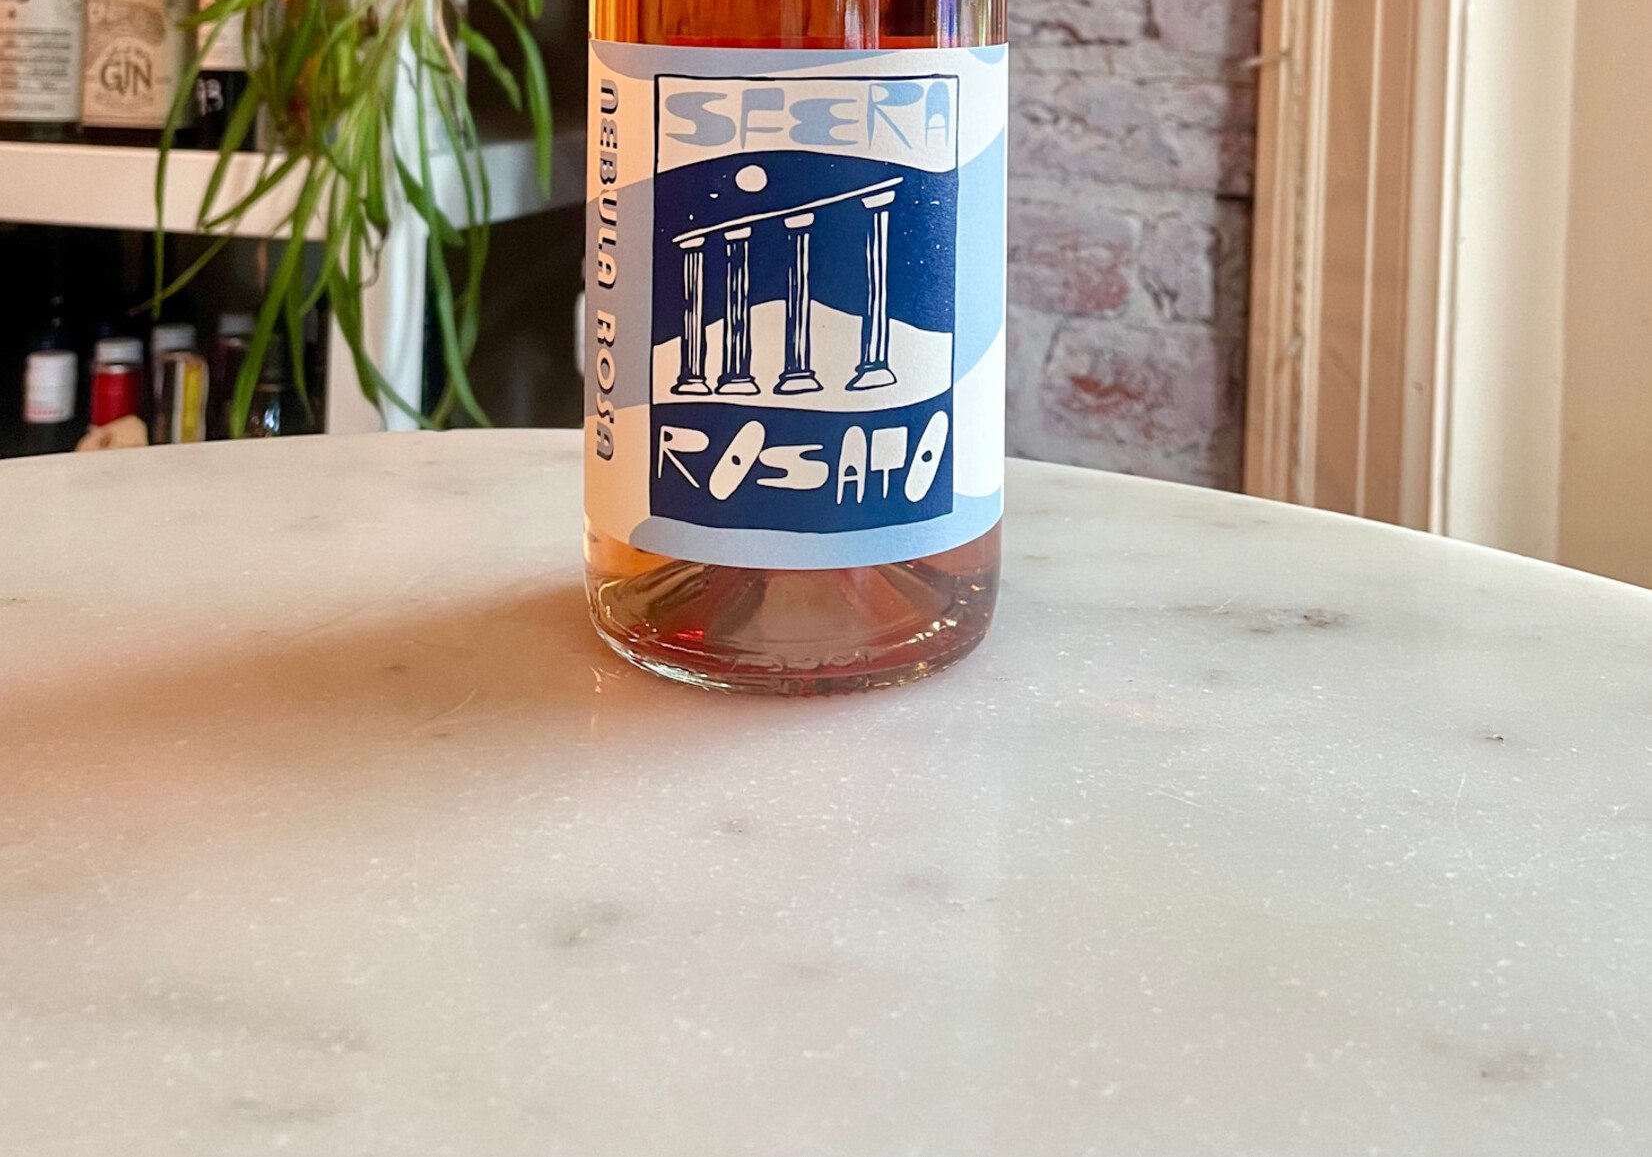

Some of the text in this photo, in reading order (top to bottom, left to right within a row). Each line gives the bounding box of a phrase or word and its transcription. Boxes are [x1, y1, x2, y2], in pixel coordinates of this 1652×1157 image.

[664, 80, 950, 150] SFERA
[596, 78, 620, 462] NEBULA ROSA
[657, 410, 950, 505] ROSATO
